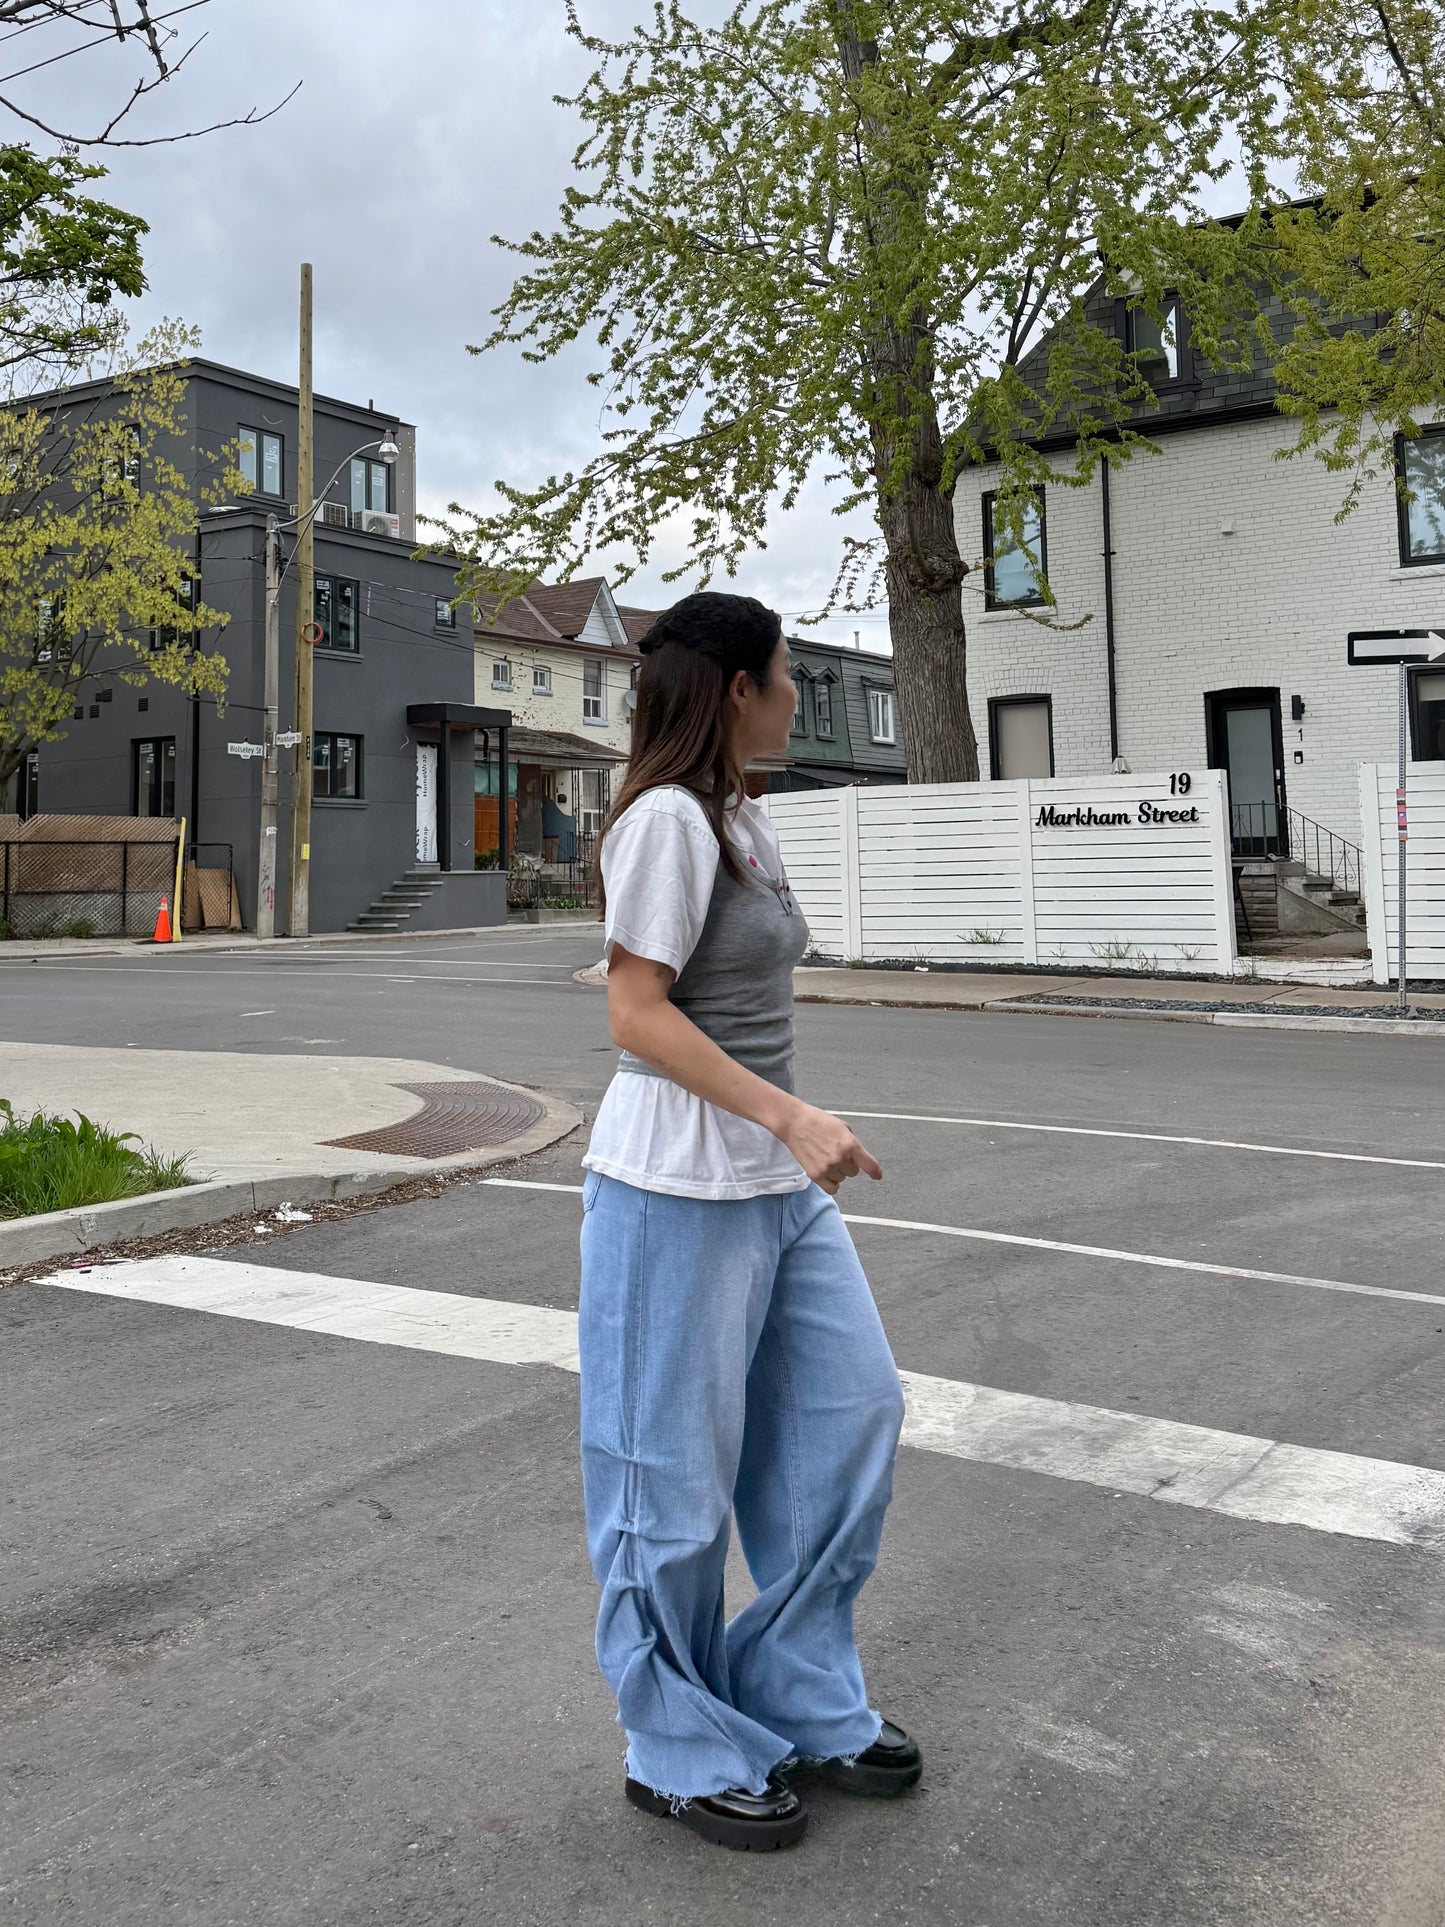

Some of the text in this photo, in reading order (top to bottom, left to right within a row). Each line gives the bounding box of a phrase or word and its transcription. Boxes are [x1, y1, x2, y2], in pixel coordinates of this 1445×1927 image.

[1298, 728, 1303, 741] 1
[230, 745, 262, 754] Wolseley St
[1168, 773, 1191, 794] 19
[1035, 802, 1199, 826] Markham Street
